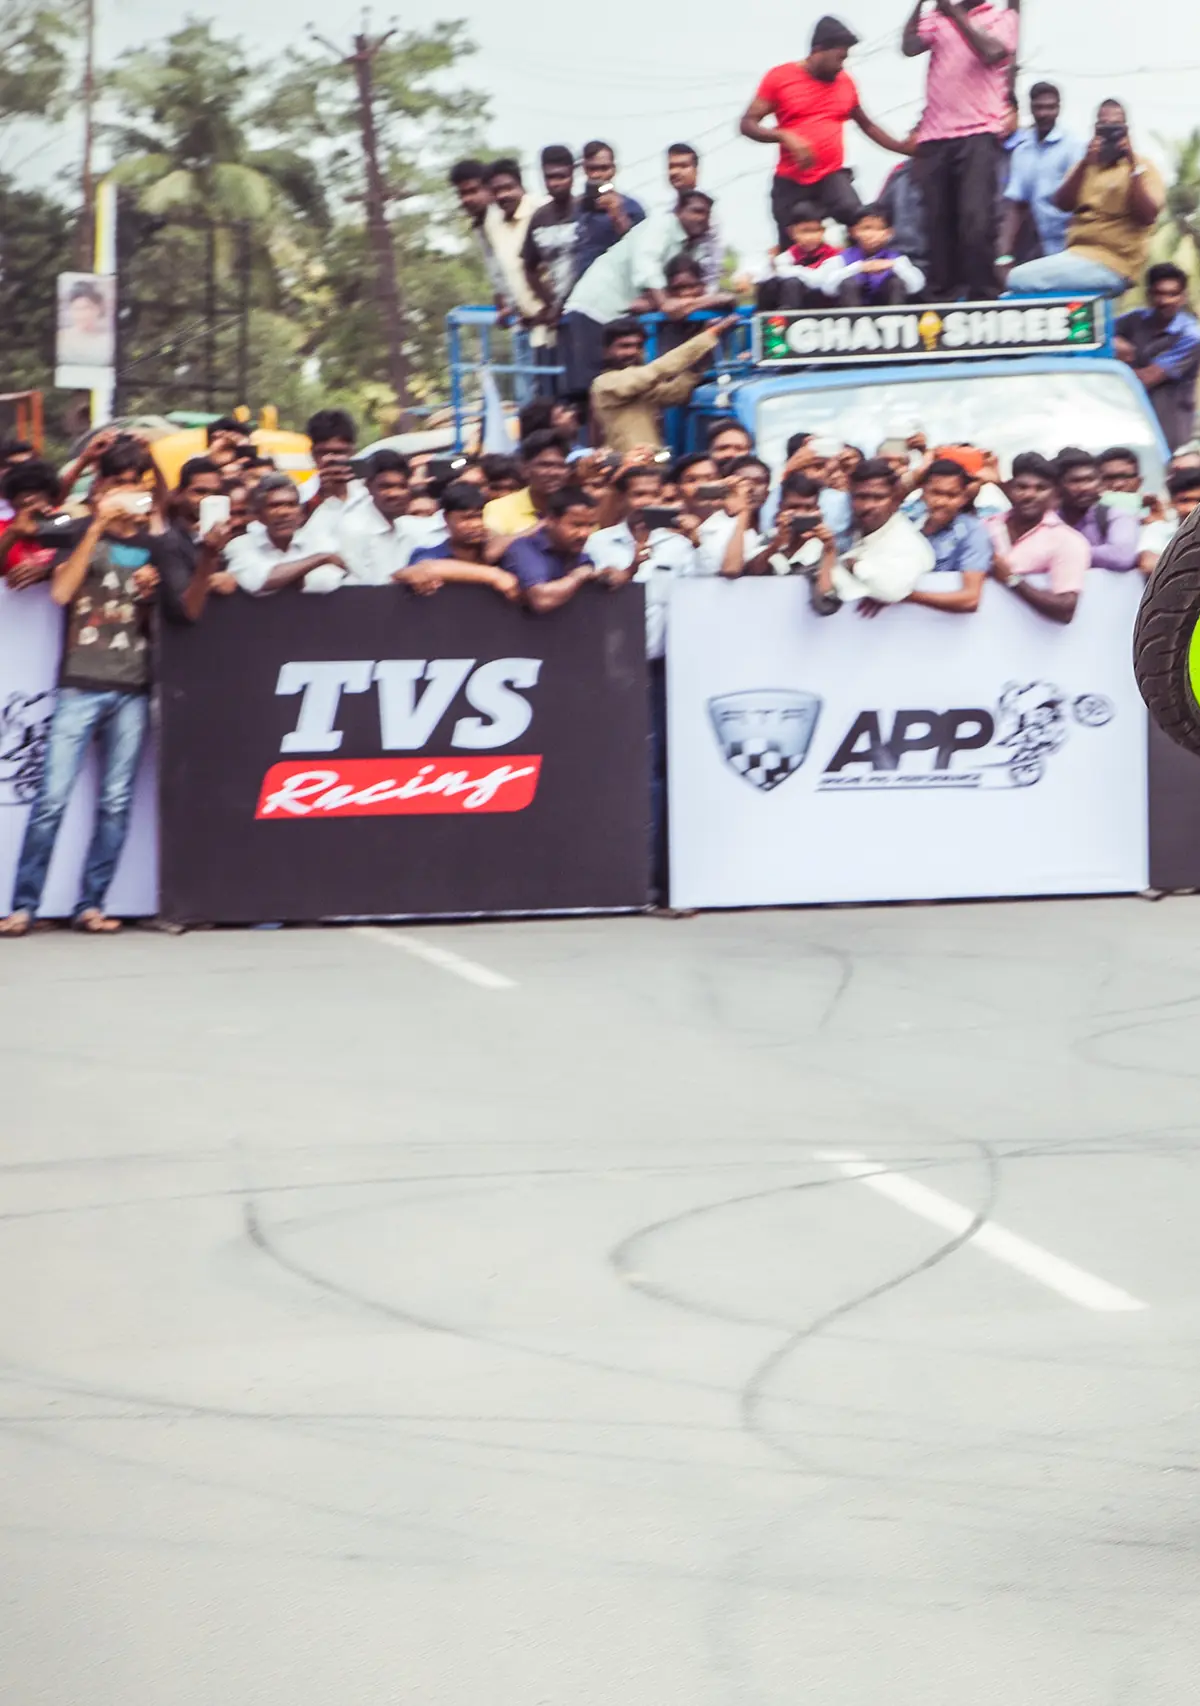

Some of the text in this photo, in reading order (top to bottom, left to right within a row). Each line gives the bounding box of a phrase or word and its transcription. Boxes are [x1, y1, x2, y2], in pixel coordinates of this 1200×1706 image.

[786, 306, 1070, 353] GHATI SHREE
[275, 656, 544, 753] TVS
[822, 707, 996, 773] APP
[261, 763, 536, 815] Racing
